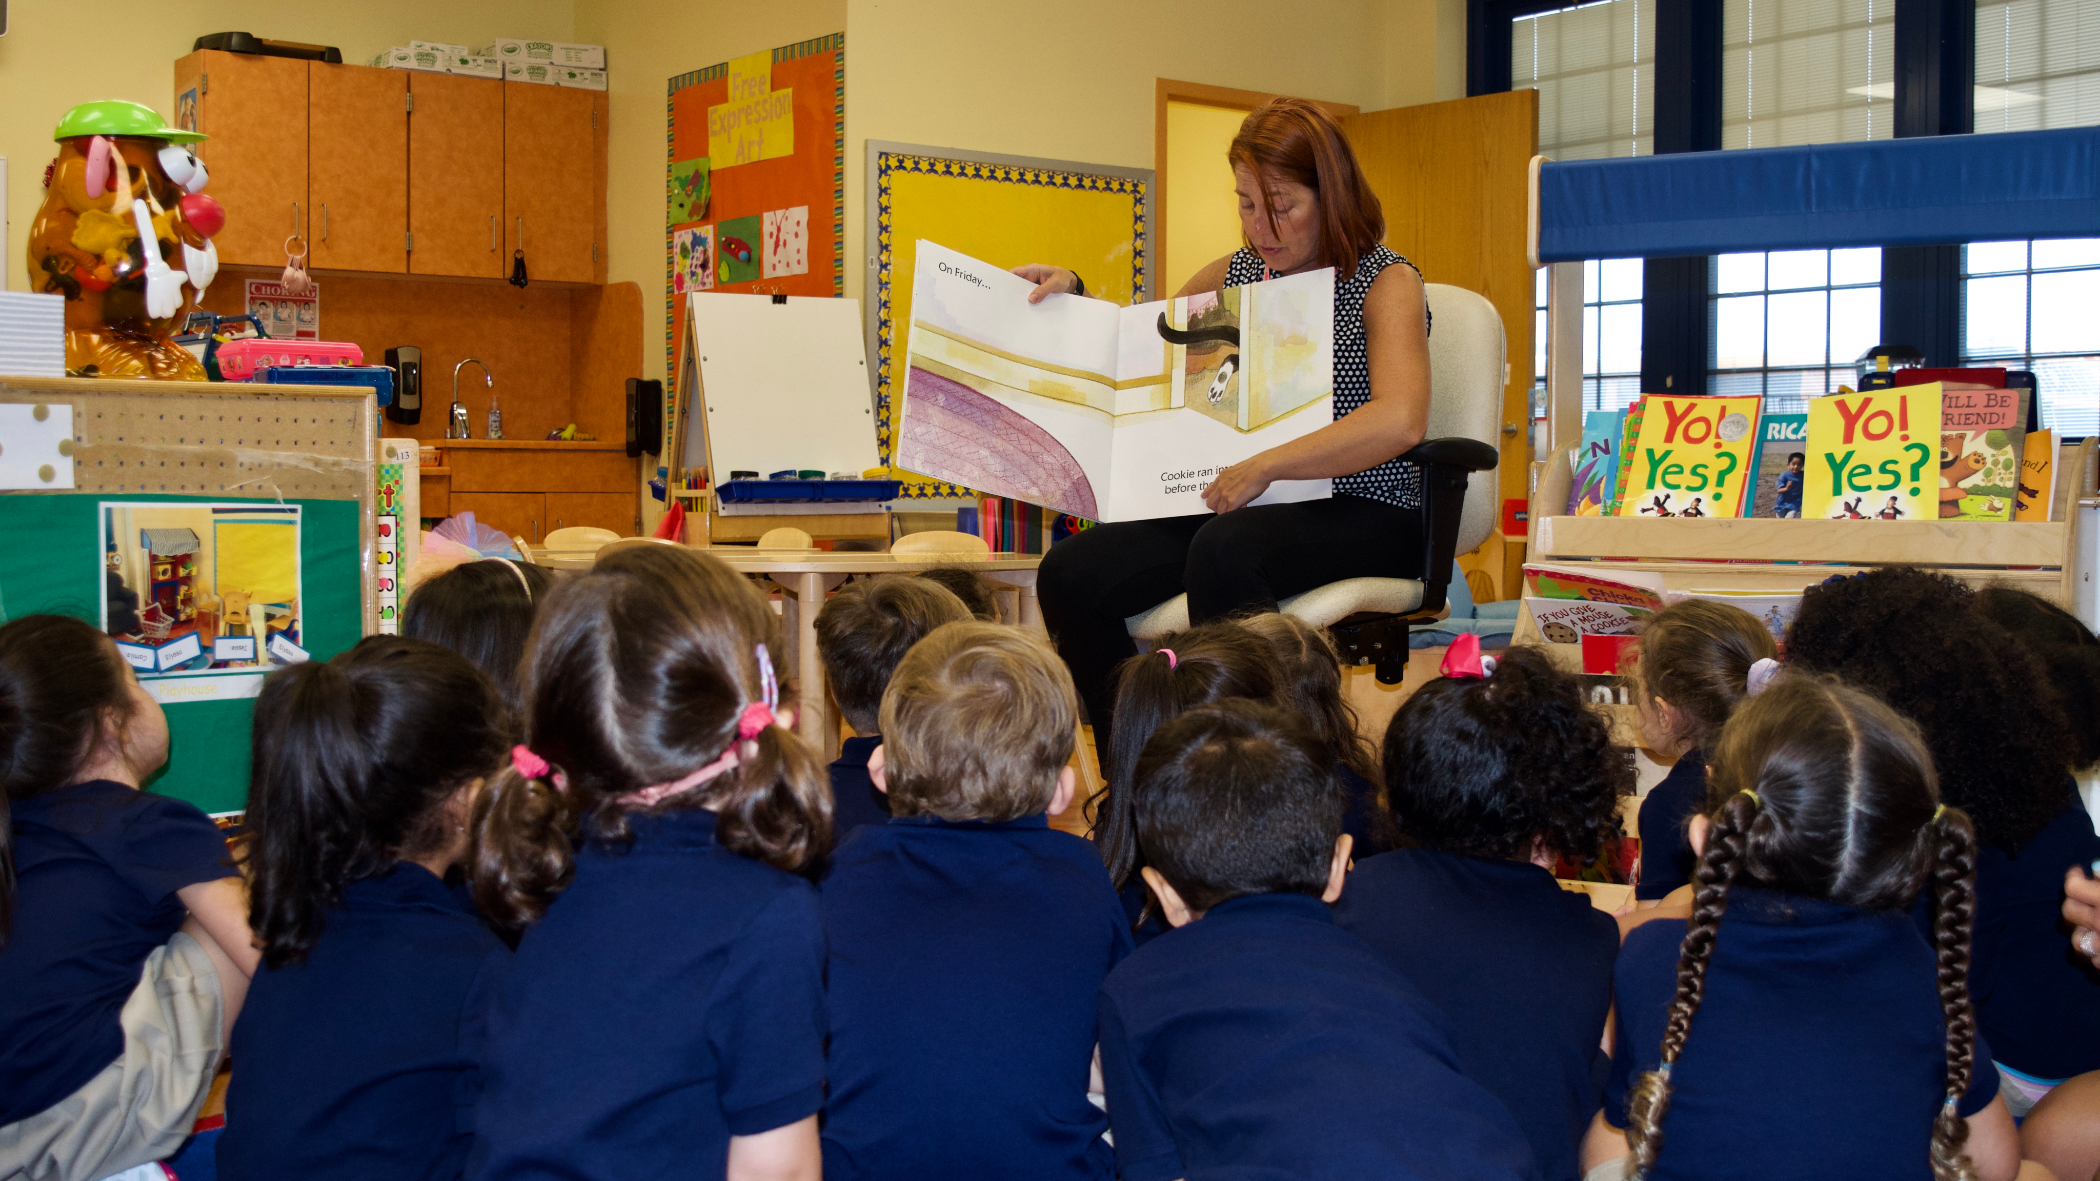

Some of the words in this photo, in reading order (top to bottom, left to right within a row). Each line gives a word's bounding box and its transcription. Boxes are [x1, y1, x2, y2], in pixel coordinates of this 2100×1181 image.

[732, 72, 766, 102] Free
[709, 92, 791, 143] Expression
[735, 129, 764, 164] Art
[938, 262, 953, 275] On
[955, 268, 991, 289] Friday...
[251, 283, 316, 298] CHOKG
[1983, 393, 2011, 408] BE
[1663, 400, 1727, 449] Yo!
[1833, 395, 1909, 445] Yo!
[1941, 412, 2006, 426] RIEND!
[1824, 443, 1930, 497] Yes?
[2022, 459, 2039, 471] nd
[1160, 470, 1195, 481] Cookie
[1197, 468, 1213, 477] ran
[1645, 448, 1738, 501] Yes?
[1164, 484, 1197, 494] before
[1587, 587, 1645, 604] Chicka
[1537, 613, 1550, 623] IF
[1549, 608, 1570, 621] YOU
[1569, 604, 1596, 616] GIVE
[1569, 619, 1579, 628] A
[1577, 611, 1614, 625] MOUSE
[1580, 626, 1589, 634] A
[1590, 617, 1629, 632] COOKIE
[158, 683, 218, 699] Playhouse
